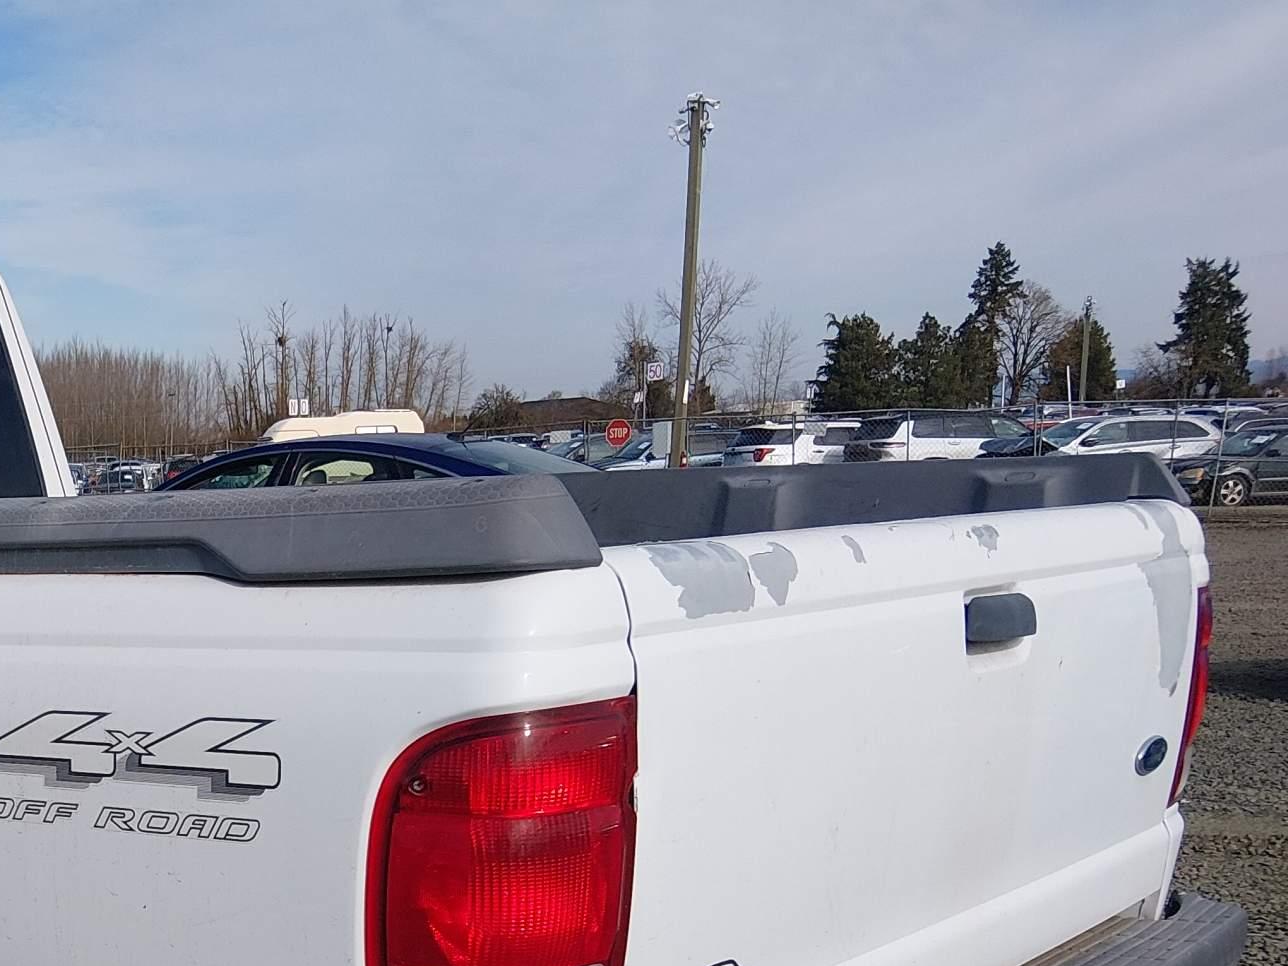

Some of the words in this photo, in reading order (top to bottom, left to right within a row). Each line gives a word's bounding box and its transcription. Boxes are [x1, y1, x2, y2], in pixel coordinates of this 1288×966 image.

[648, 364, 663, 379] 50
[609, 427, 629, 439] STOP
[93, 806, 262, 842] ROAD
